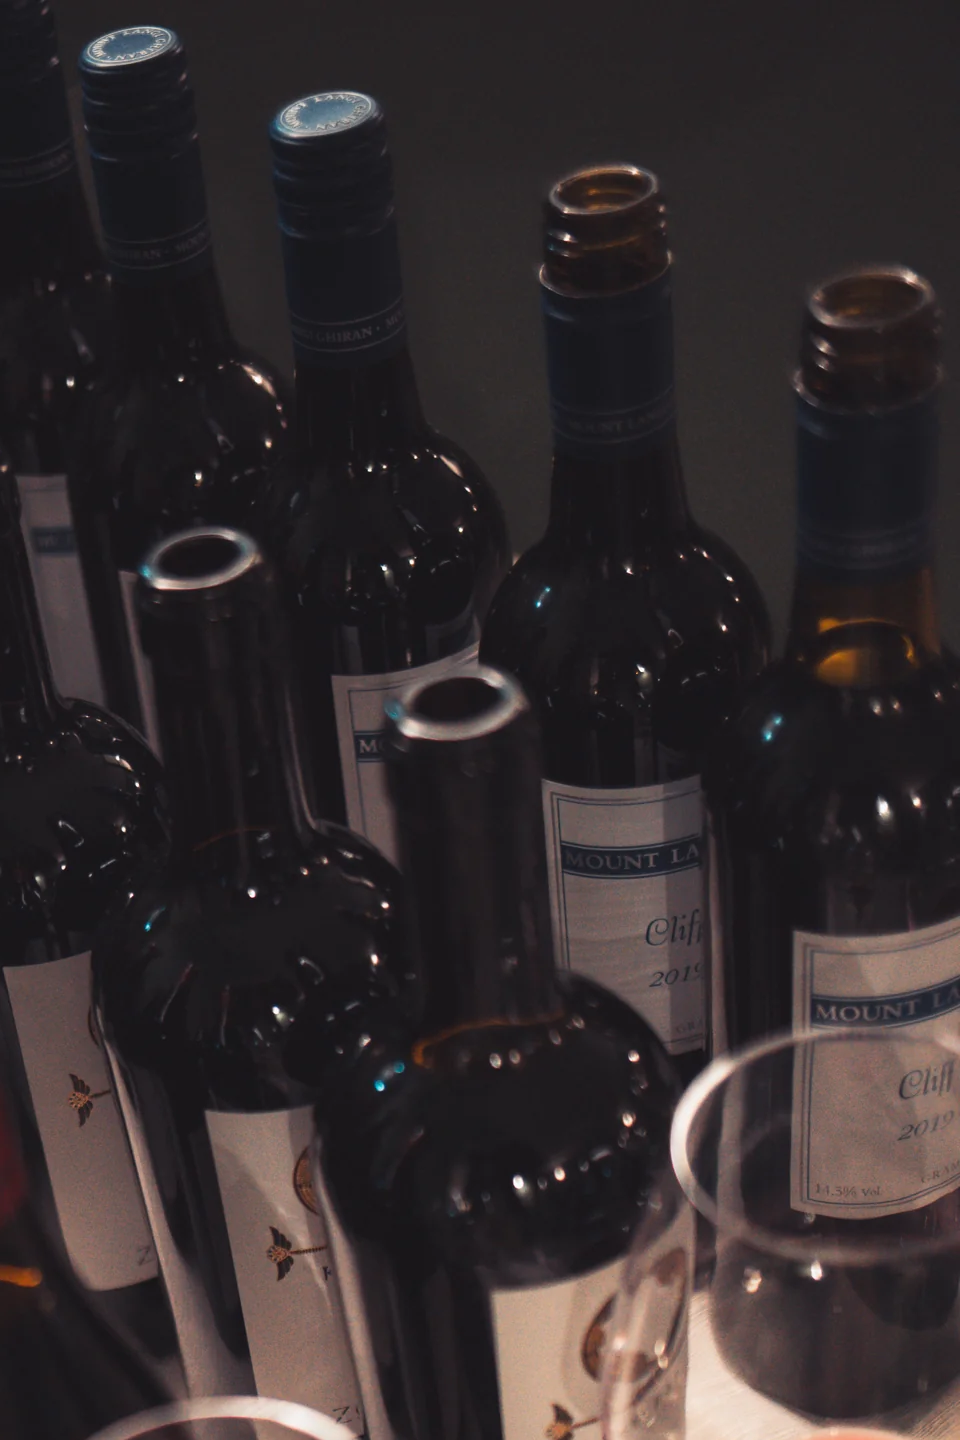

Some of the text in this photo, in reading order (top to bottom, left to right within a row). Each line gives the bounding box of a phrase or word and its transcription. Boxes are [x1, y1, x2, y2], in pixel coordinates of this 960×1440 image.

[315, 325, 373, 343] GHIRAN
[563, 848, 660, 871] MOUNT
[815, 998, 920, 1023] MOUNT
[897, 1109, 955, 1142] 2019
